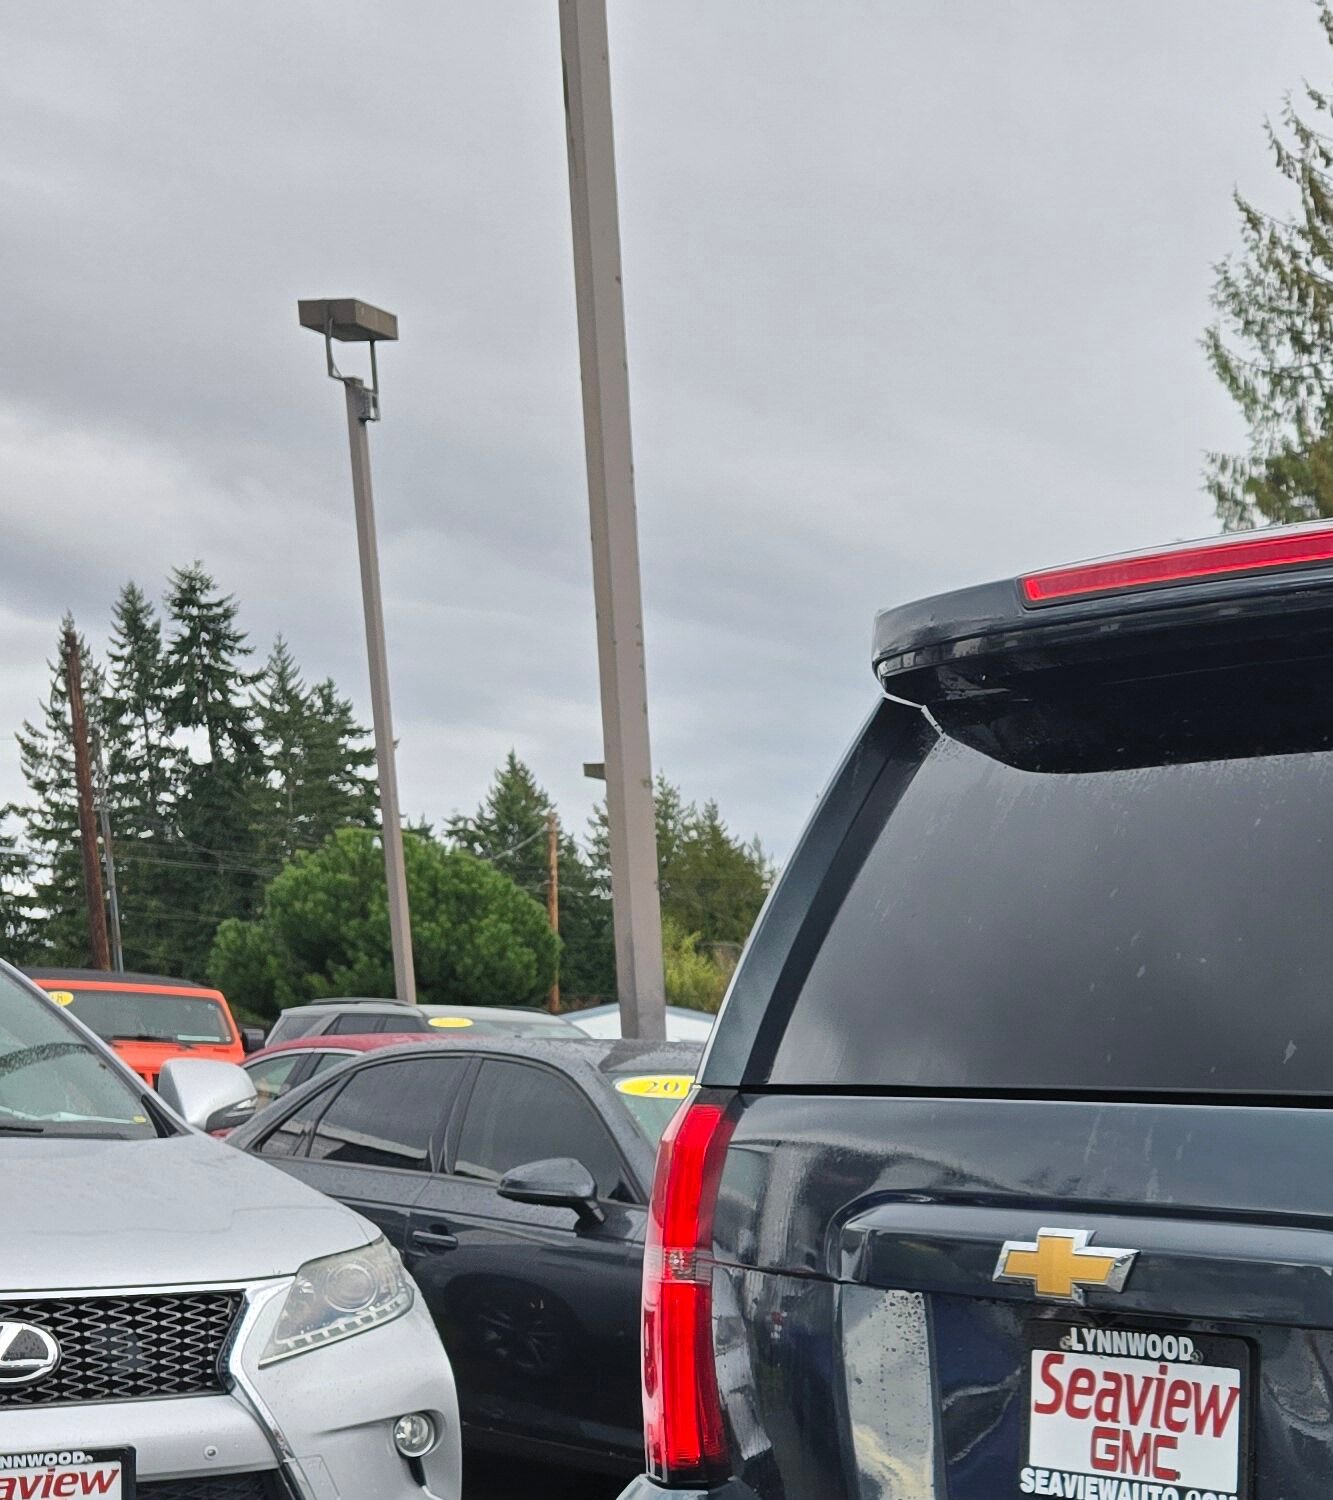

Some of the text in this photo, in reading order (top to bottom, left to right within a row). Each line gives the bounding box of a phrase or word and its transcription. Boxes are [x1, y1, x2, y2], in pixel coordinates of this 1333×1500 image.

[1069, 1326, 1195, 1362] LYNNWOOD
[1034, 1352, 1241, 1438] Seaview
[1090, 1426, 1181, 1482] GMC
